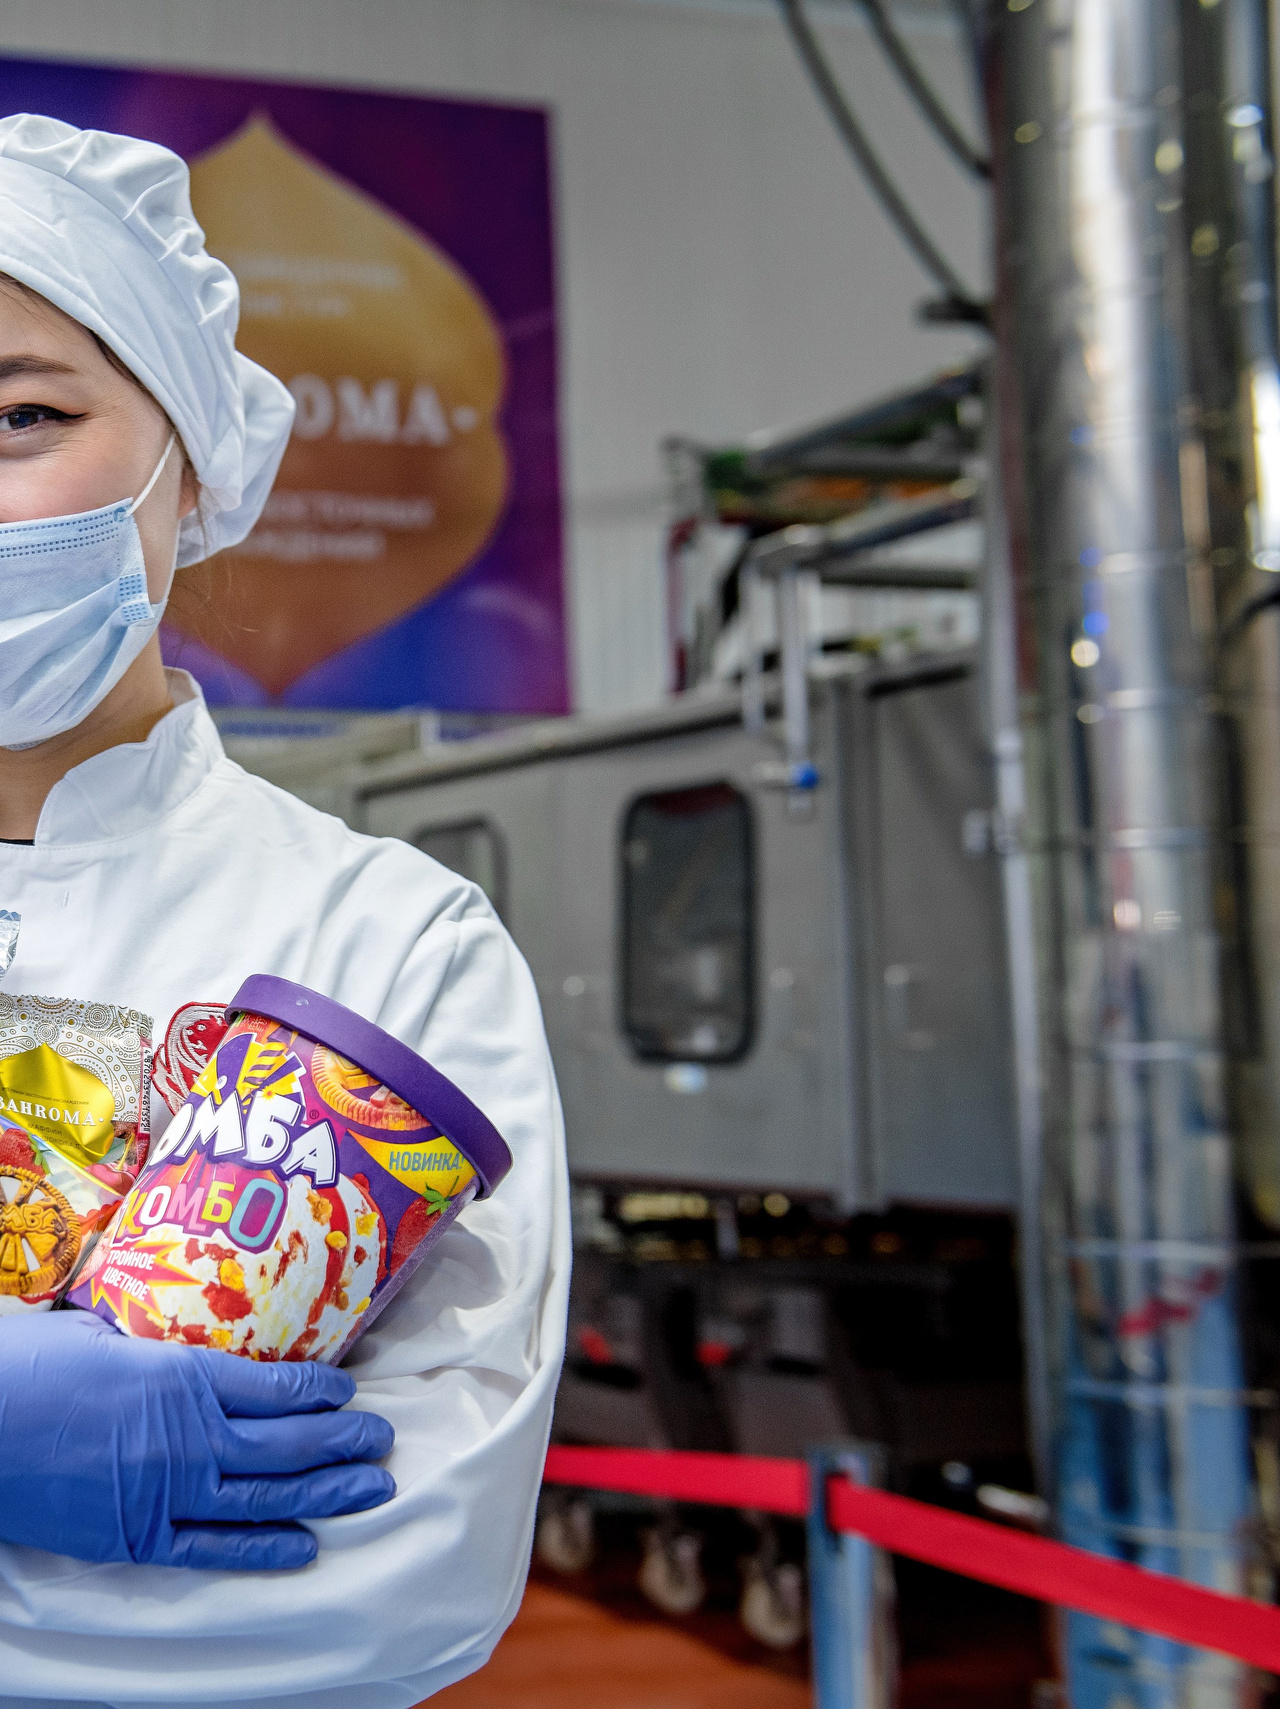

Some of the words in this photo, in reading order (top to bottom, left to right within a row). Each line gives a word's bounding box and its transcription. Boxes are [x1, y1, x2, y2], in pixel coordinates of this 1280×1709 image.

[149, 1090, 336, 1187] ОМБА
[389, 1150, 464, 1171] НОВИНКА!
[116, 1177, 285, 1248] КОМБО
[107, 1247, 157, 1271] ТРОЙНОЕ
[101, 1265, 151, 1301] ЦВЕТНОЕ
